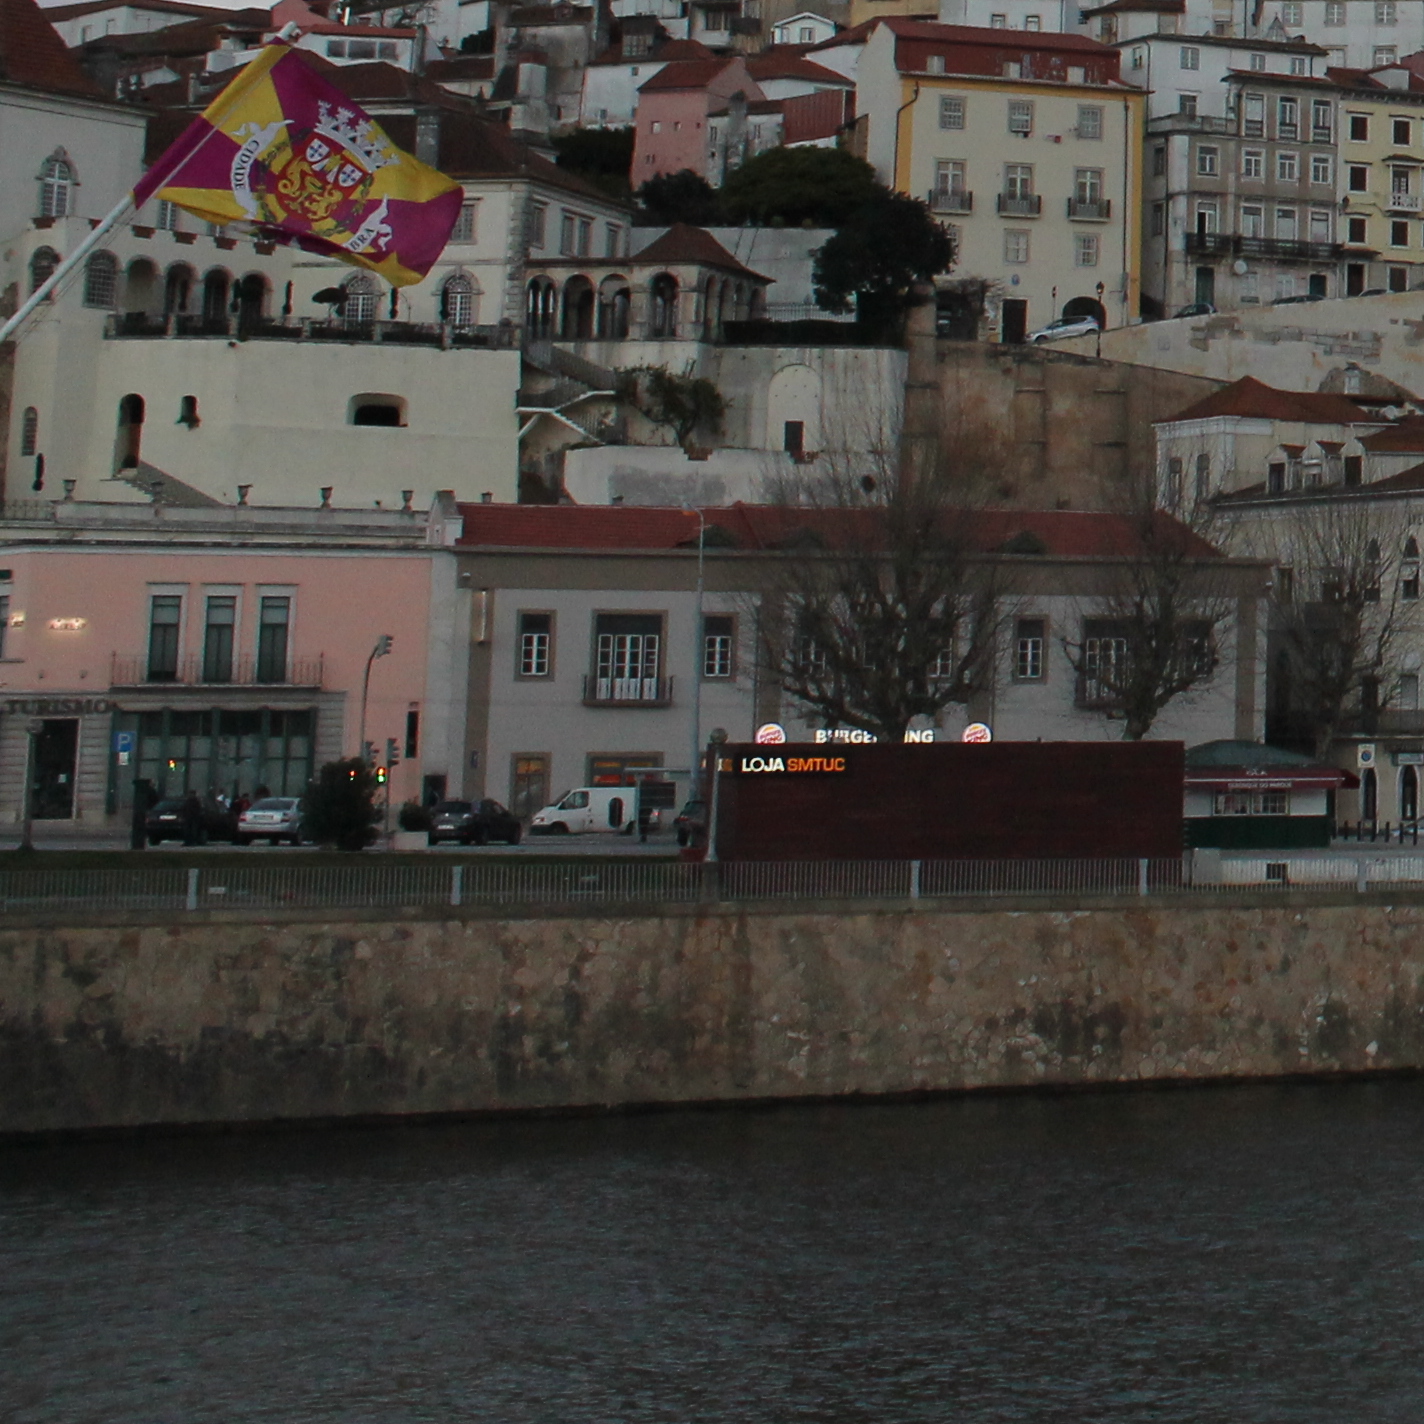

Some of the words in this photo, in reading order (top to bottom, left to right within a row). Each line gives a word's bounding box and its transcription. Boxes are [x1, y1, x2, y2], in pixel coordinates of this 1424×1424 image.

[235, 139, 260, 190] CIDADE
[349, 227, 375, 251] BRA
[118, 733, 131, 751] P
[815, 729, 878, 743] BURGE
[904, 729, 934, 743] ING
[741, 757, 785, 772] LOJA
[787, 757, 845, 772] SMTUC
